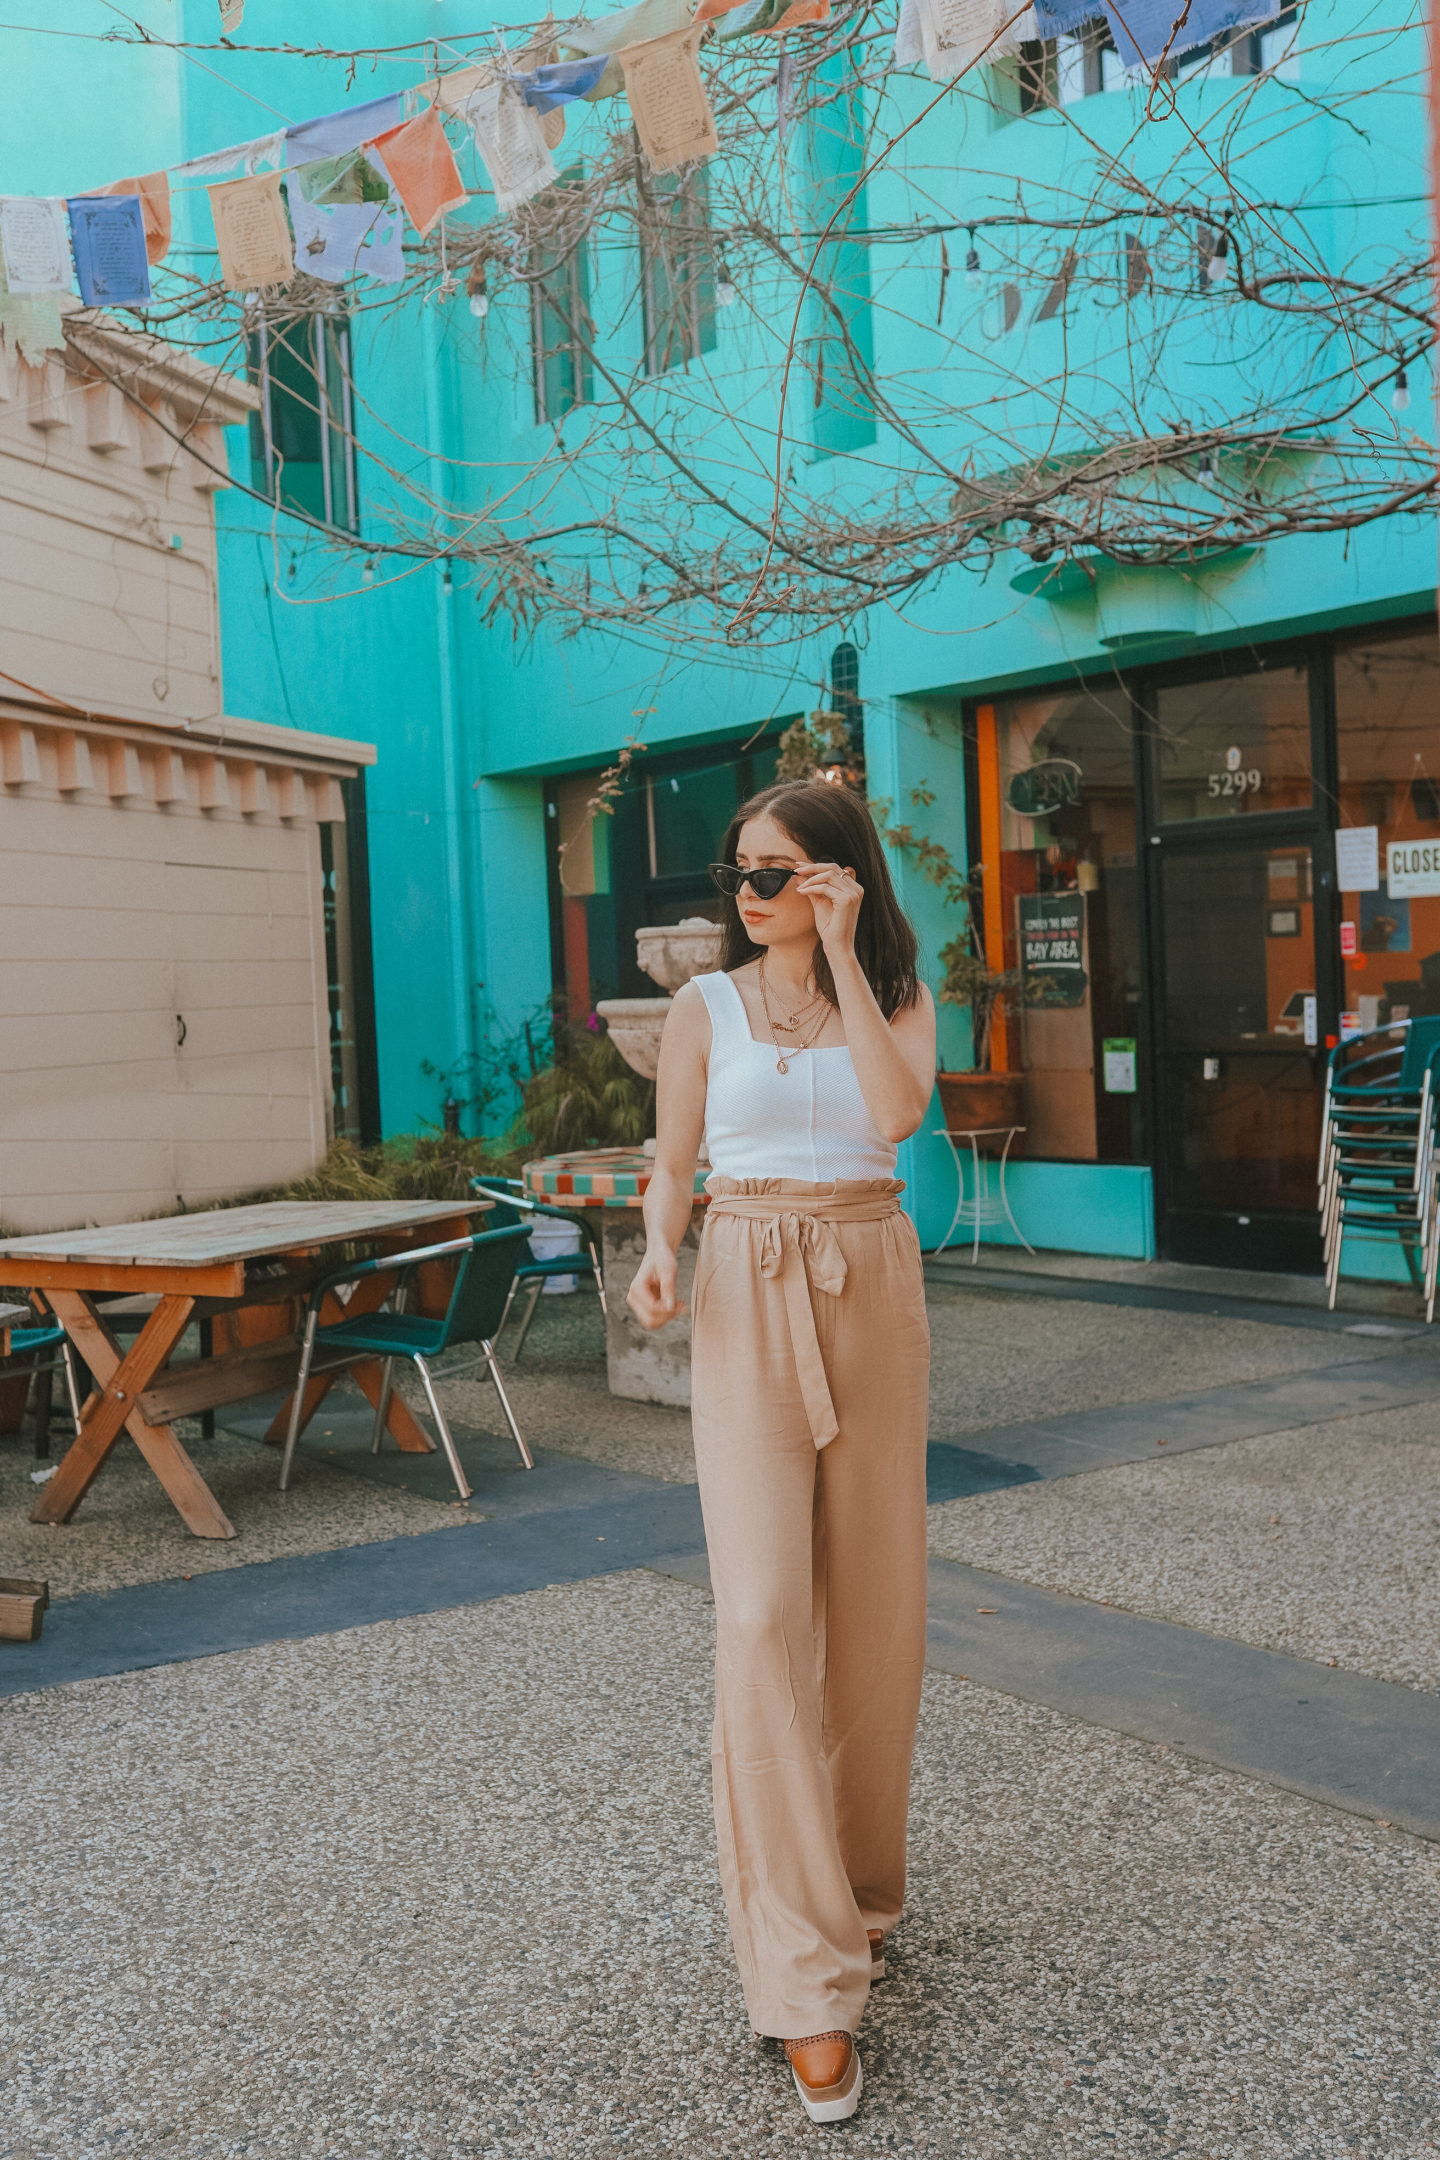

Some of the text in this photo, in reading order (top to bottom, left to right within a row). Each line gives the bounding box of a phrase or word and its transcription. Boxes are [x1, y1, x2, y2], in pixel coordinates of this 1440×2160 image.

[1208, 769, 1261, 797] 5299
[1393, 848, 1440, 874] CLOSE
[1026, 940, 1078, 960] BAY AREA
